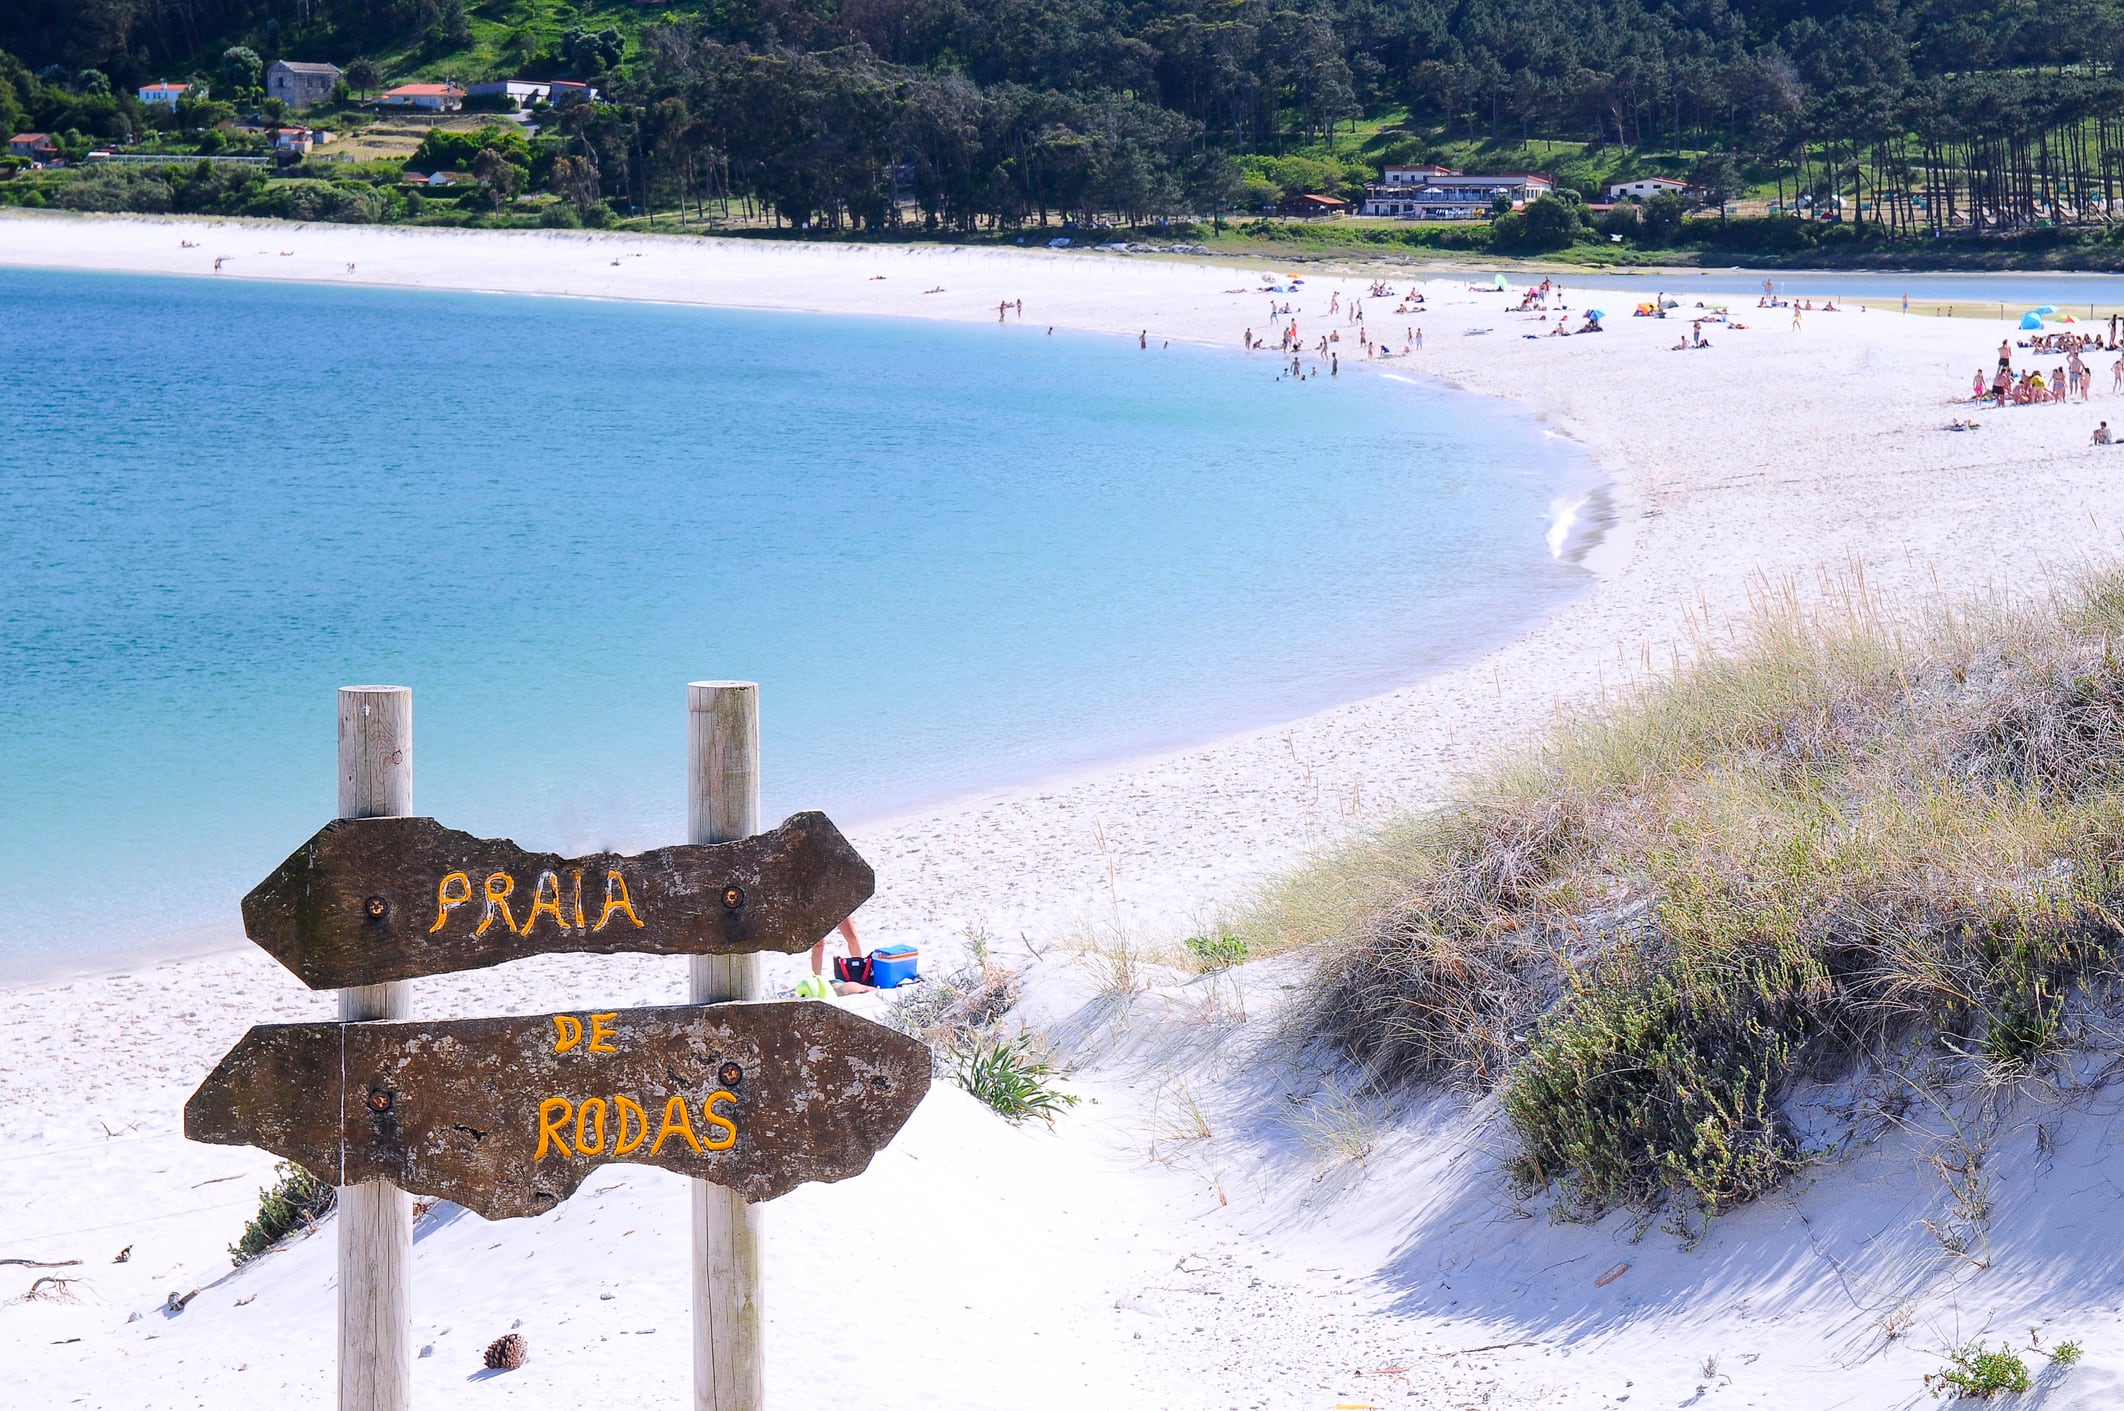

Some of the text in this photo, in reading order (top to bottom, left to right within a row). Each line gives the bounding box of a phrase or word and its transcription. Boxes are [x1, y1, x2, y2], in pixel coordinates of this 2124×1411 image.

[430, 871, 644, 935] PRAIA
[555, 1012, 618, 1053] DE
[534, 1091, 737, 1160] RODAS
